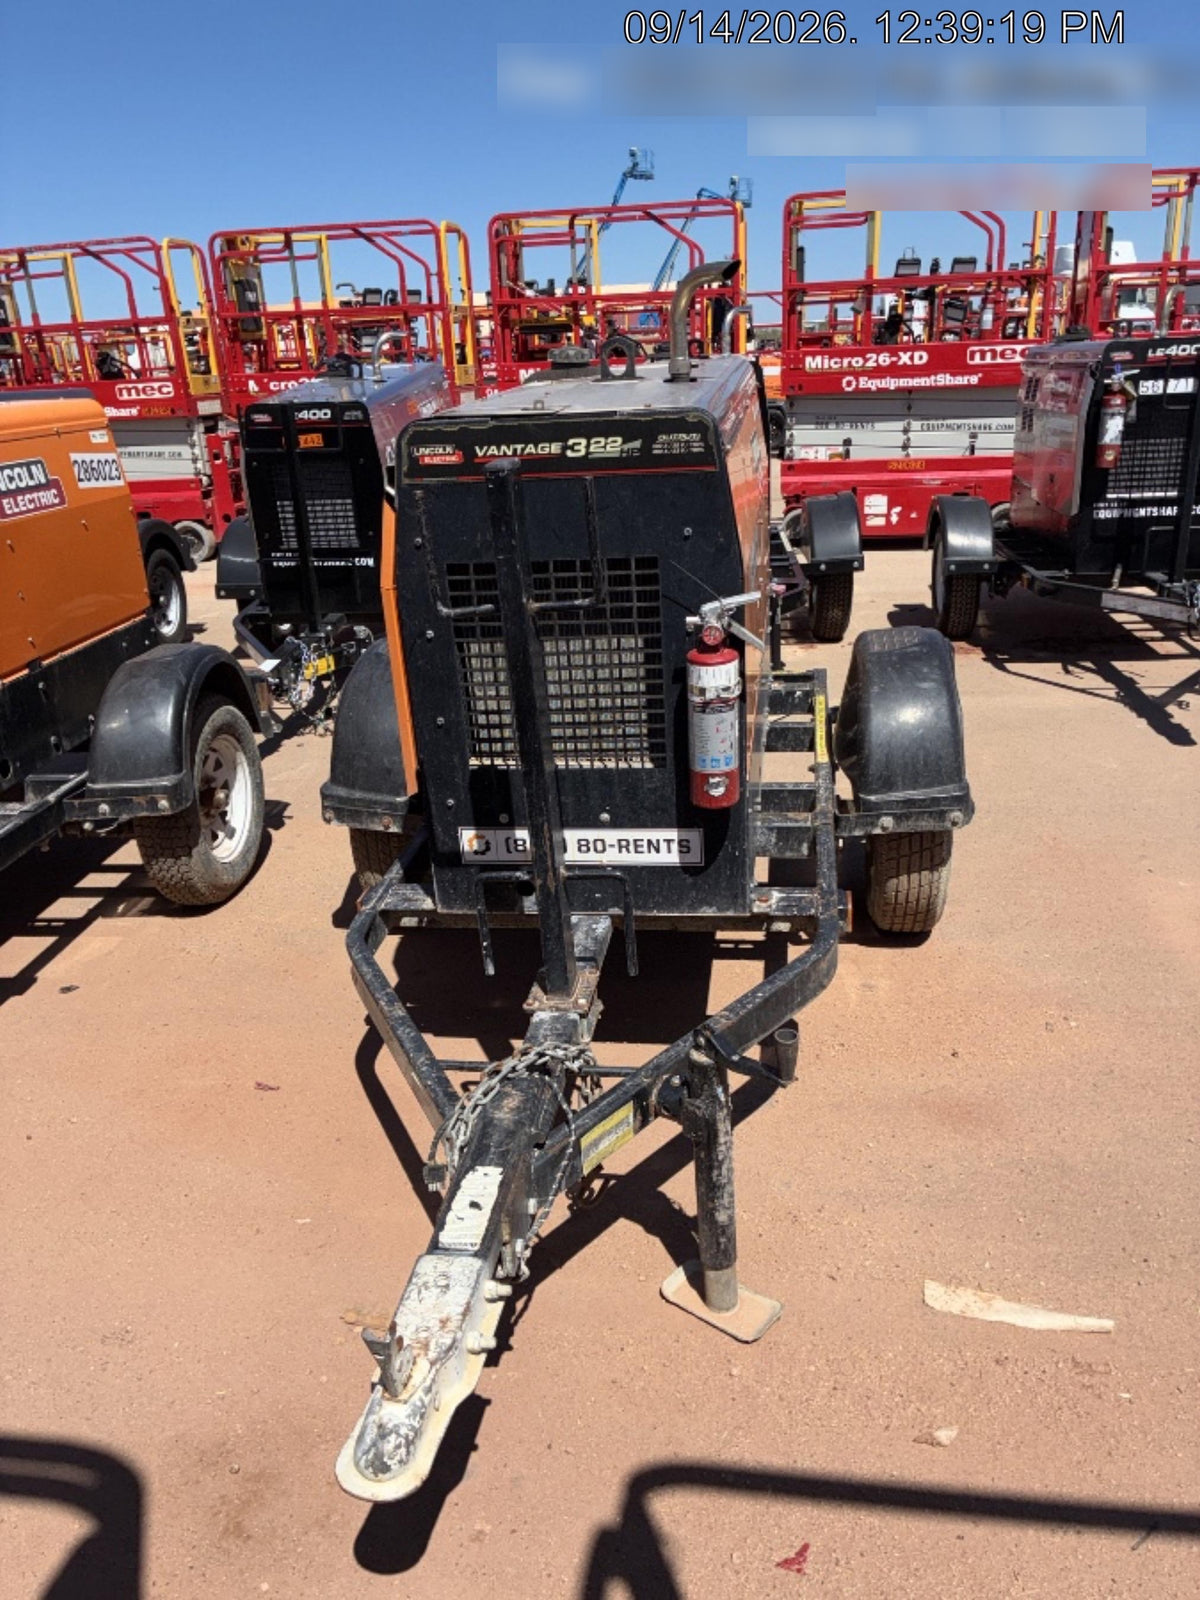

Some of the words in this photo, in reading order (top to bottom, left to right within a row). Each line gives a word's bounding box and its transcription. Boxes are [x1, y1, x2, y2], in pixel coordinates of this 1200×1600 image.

[859, 375, 977, 390] EquipmentShare
[474, 442, 563, 457] VANTAGE
[565, 437, 622, 458] 322
[2, 489, 59, 514] ELECTRIC
[577, 838, 691, 854] 80-RENTS
